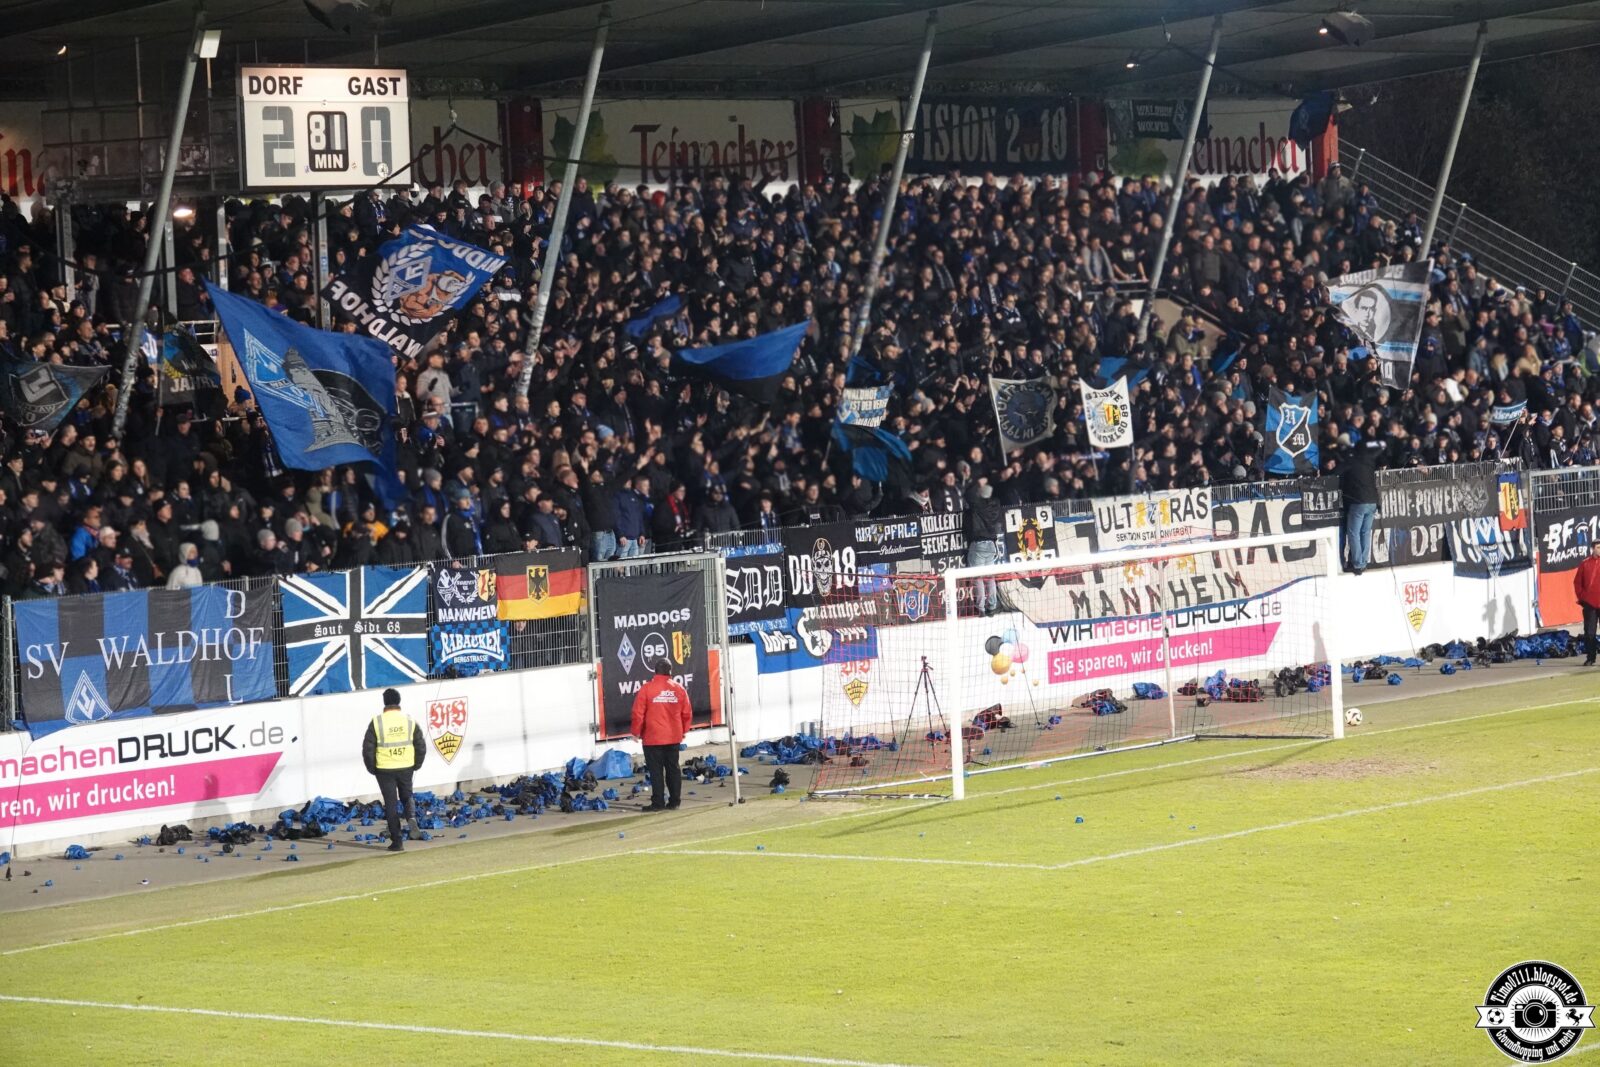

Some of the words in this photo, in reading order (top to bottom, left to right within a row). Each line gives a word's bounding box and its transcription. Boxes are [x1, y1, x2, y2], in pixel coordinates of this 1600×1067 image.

[249, 75, 304, 95] DORF
[348, 76, 401, 96] GAST
[262, 106, 296, 177] 2
[360, 106, 393, 176] 0
[315, 154, 344, 169] MIN
[629, 124, 795, 184] Teinacher
[921, 512, 963, 534] KOLLEKTI
[1040, 510, 1049, 522] 9
[1098, 502, 1132, 533] ULT
[1170, 491, 1209, 523] RAS
[921, 534, 949, 555] SECHS
[788, 554, 813, 595] DD
[832, 546, 857, 589] 18
[1069, 571, 1249, 620] MANNHEIM
[354, 620, 380, 633] Side
[387, 621, 401, 633] 68
[614, 608, 691, 629] MADDOGS
[26, 641, 70, 680] SV
[96, 626, 265, 672] WALDHOF
[441, 629, 502, 659] RABAUKEN
[644, 644, 665, 658] 95
[454, 655, 489, 664] BERGSTRASSE
[1053, 657, 1074, 676] Sie
[1078, 652, 1128, 676] sparen,
[1132, 646, 1151, 663] wir
[1156, 638, 1213, 662] ducken!
[618, 674, 694, 695] WAOF
[47, 788, 80, 812] wir
[87, 774, 176, 807] drucken!
